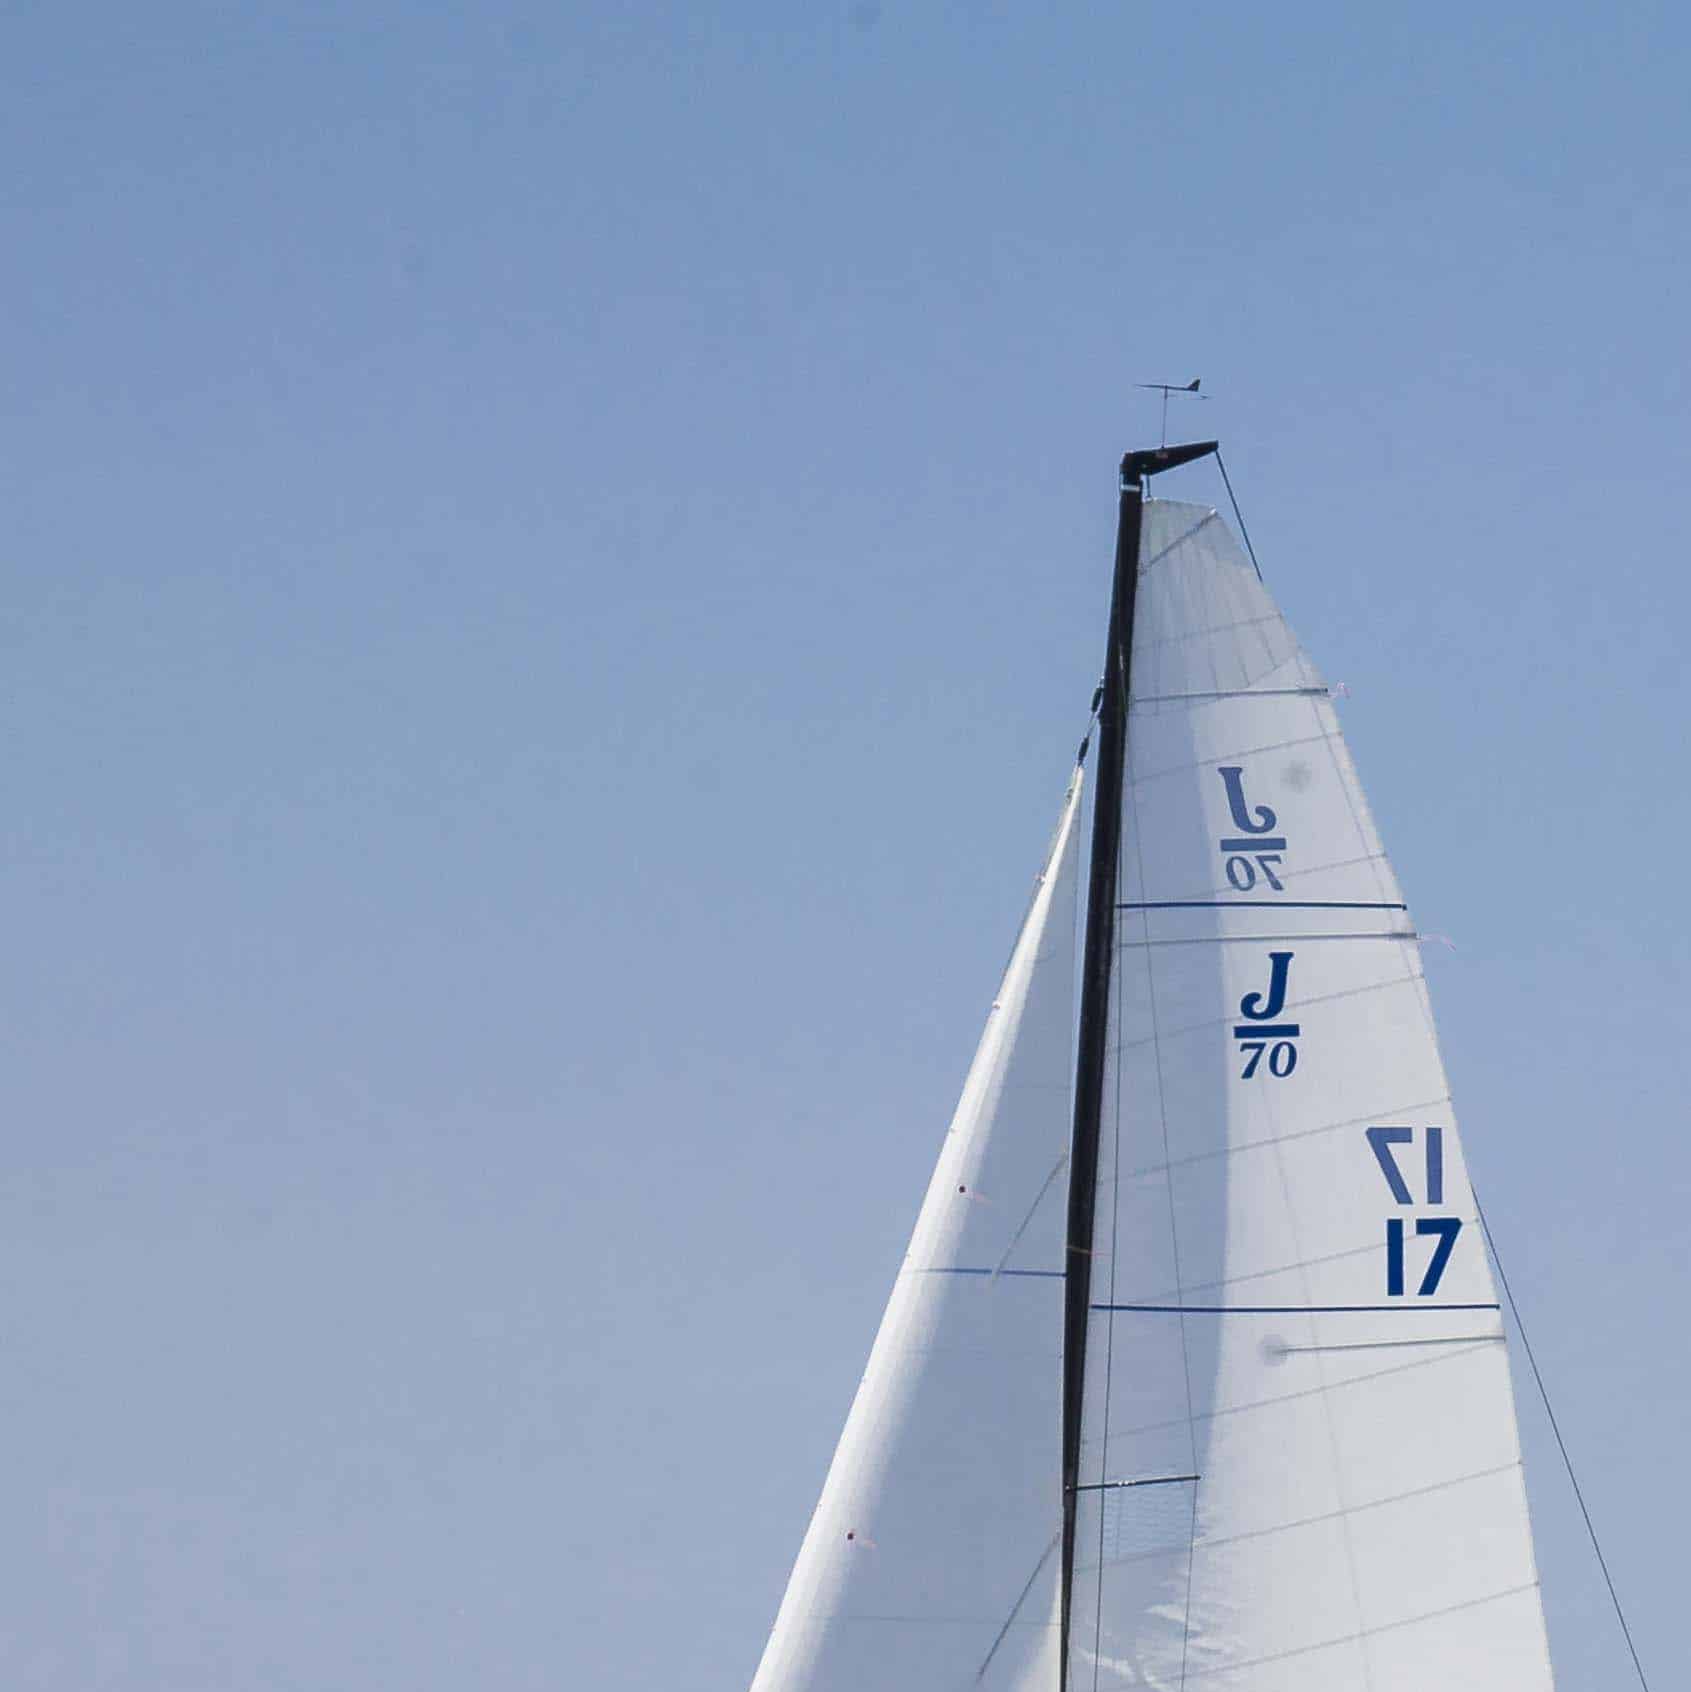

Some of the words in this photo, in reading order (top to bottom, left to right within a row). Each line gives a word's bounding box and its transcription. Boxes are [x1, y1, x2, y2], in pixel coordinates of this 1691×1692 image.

[1240, 951, 1294, 1021] J
[1239, 1041, 1298, 1080] 70
[1386, 1217, 1463, 1297] 17
